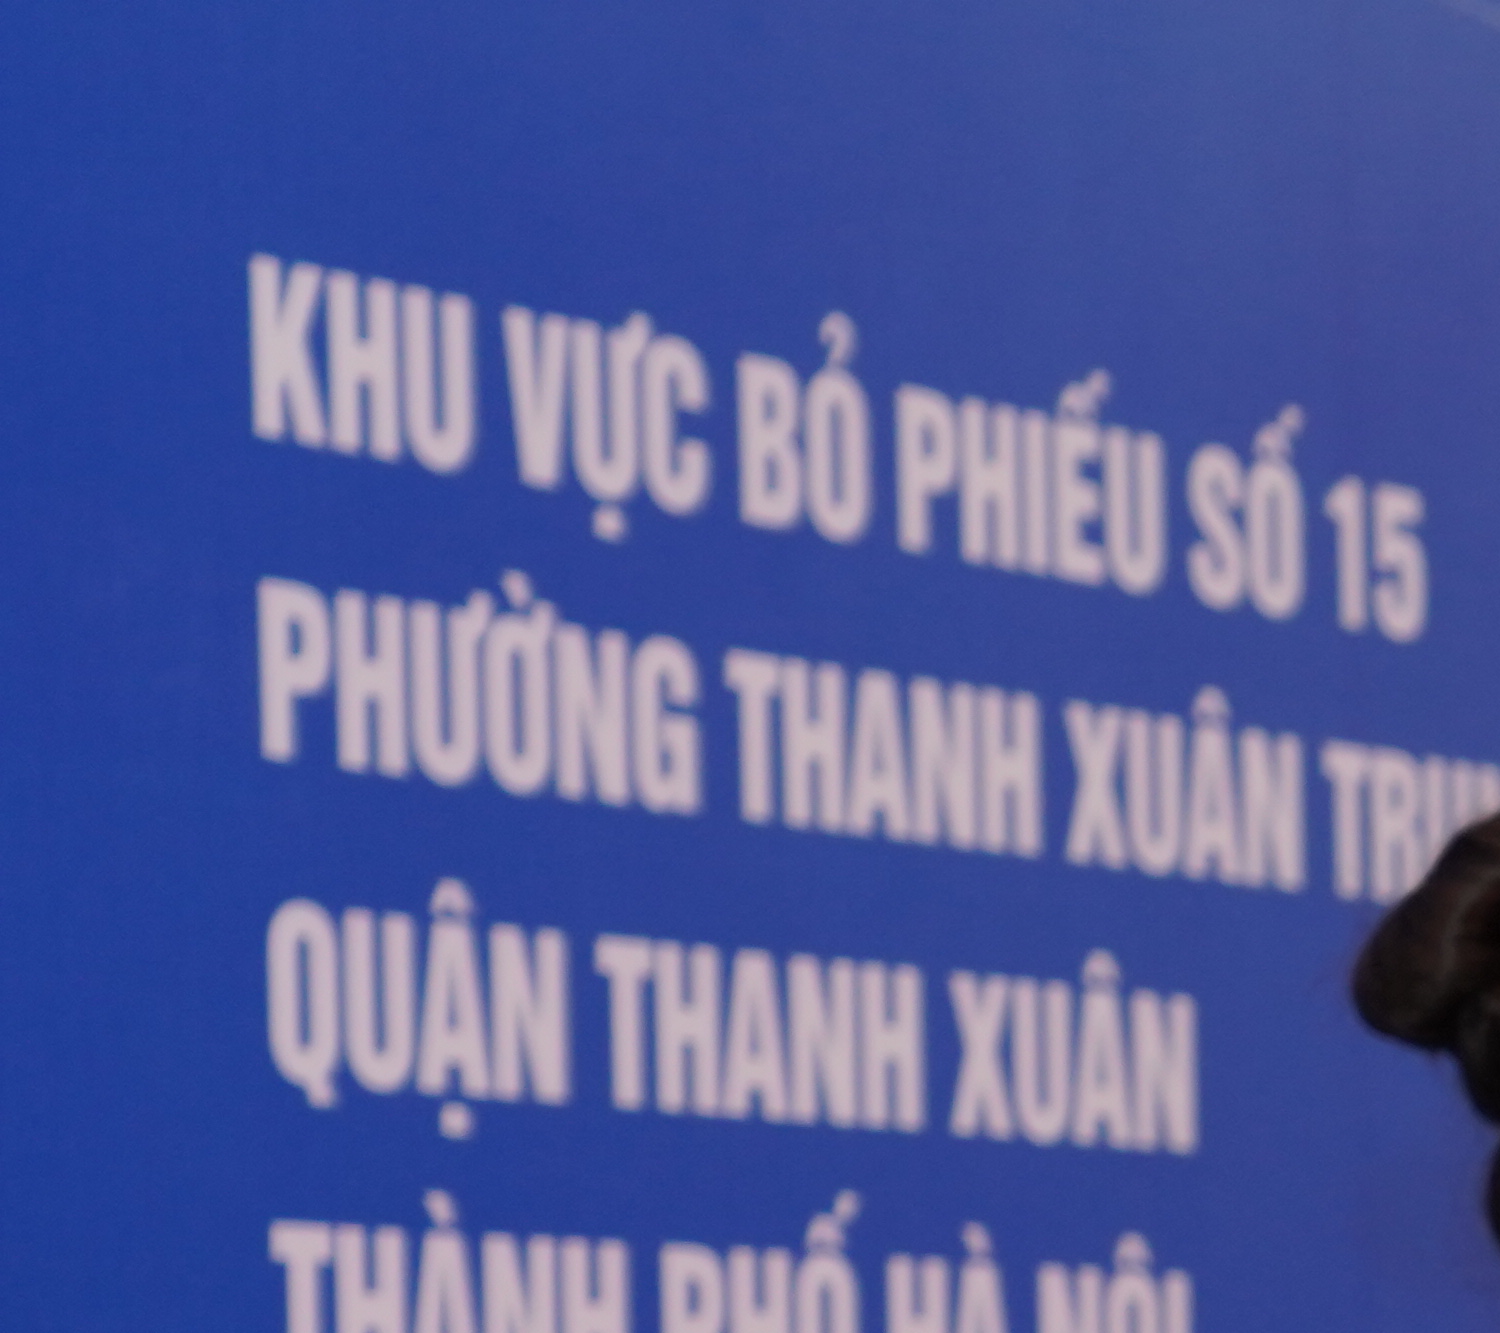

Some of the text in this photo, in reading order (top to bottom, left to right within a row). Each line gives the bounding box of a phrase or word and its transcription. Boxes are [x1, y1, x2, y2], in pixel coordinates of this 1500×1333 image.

[249, 254, 1428, 642] KHU VỰC BỎ PHIẾU SỐ 15
[258, 571, 701, 814] PHƯỜNG
[724, 648, 1043, 857] THANH
[1065, 687, 1305, 891] XUÂN
[266, 879, 1197, 1153] QUẬN THANH XUÂN
